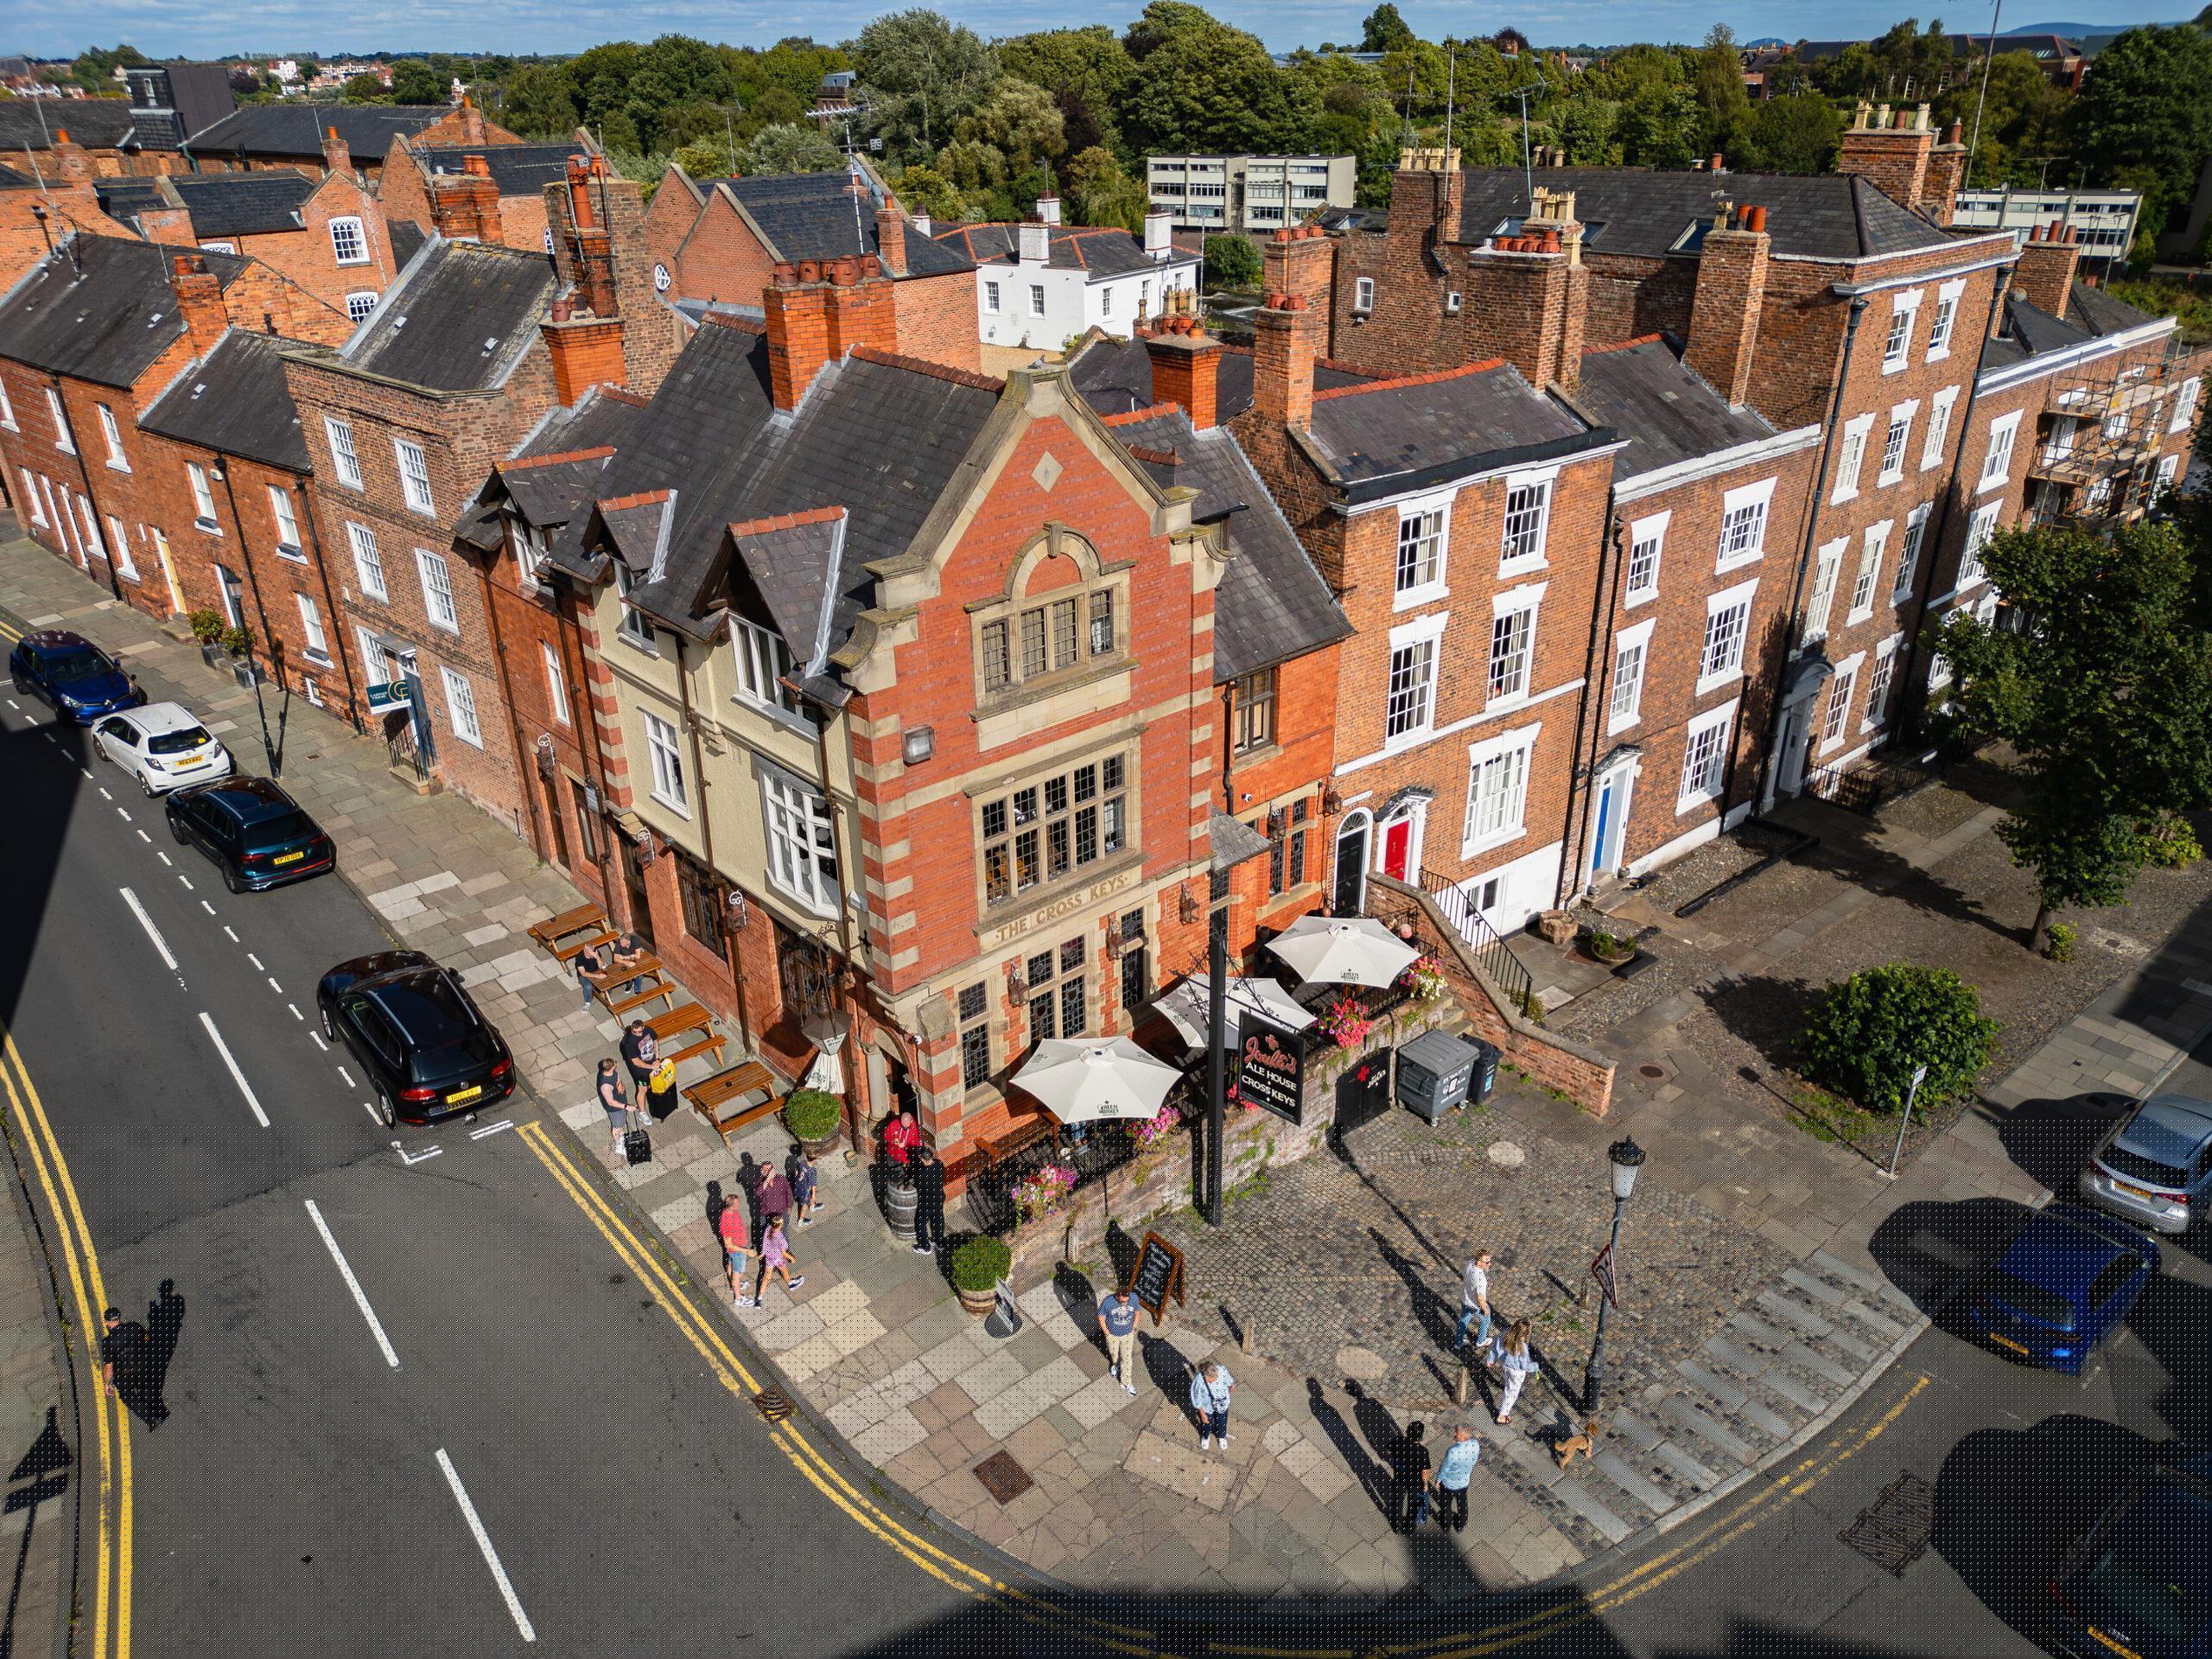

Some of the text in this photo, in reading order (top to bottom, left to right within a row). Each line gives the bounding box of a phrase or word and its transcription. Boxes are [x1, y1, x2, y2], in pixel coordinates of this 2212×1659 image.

[997, 874, 1125, 942] THE CROSS KEYS
[1242, 1075, 1296, 1107] CROSS KEYS
[1245, 1061, 1297, 1091] ALE HOUSE
